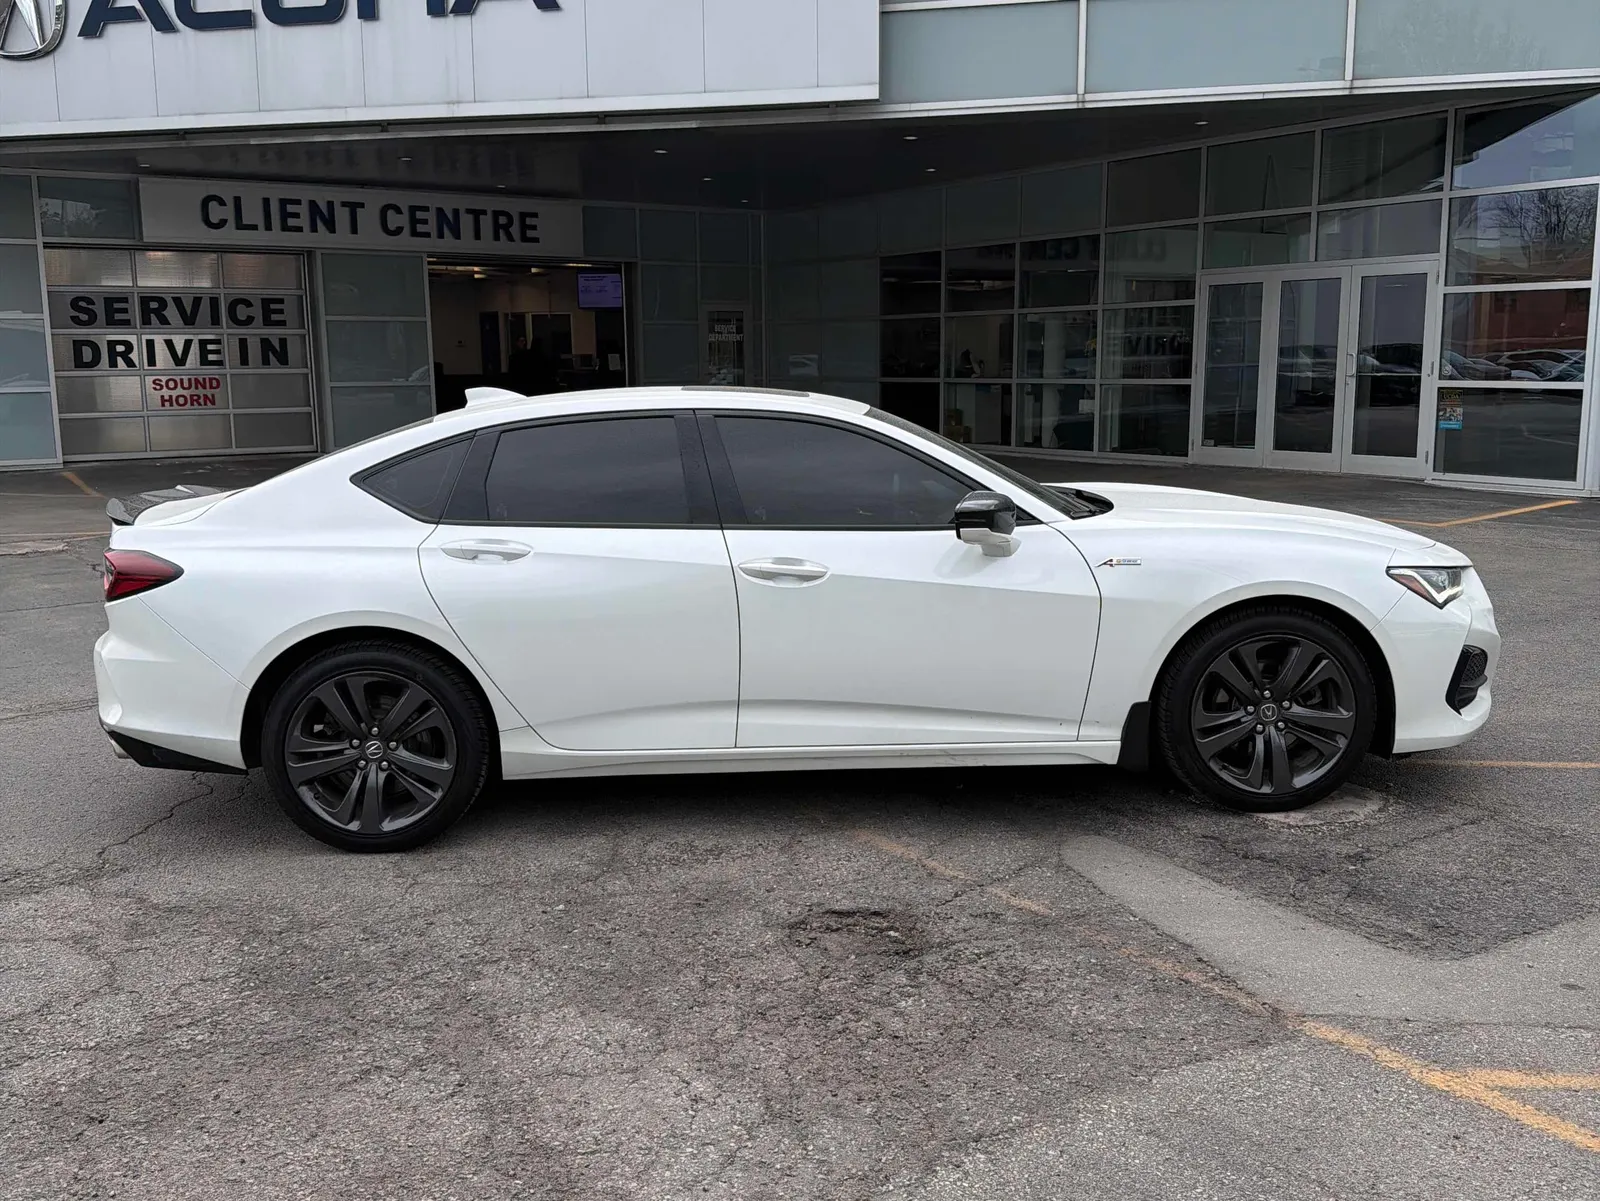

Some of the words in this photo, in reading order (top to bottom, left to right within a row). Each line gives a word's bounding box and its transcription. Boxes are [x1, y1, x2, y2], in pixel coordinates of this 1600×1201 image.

[201, 194, 365, 235] CLIENT
[379, 203, 540, 243] CENTRE
[69, 295, 288, 327] SERVICE
[72, 338, 224, 369] DRIVE
[238, 337, 289, 367] IN
[152, 376, 221, 391] SOUND
[160, 393, 216, 408] HORN
